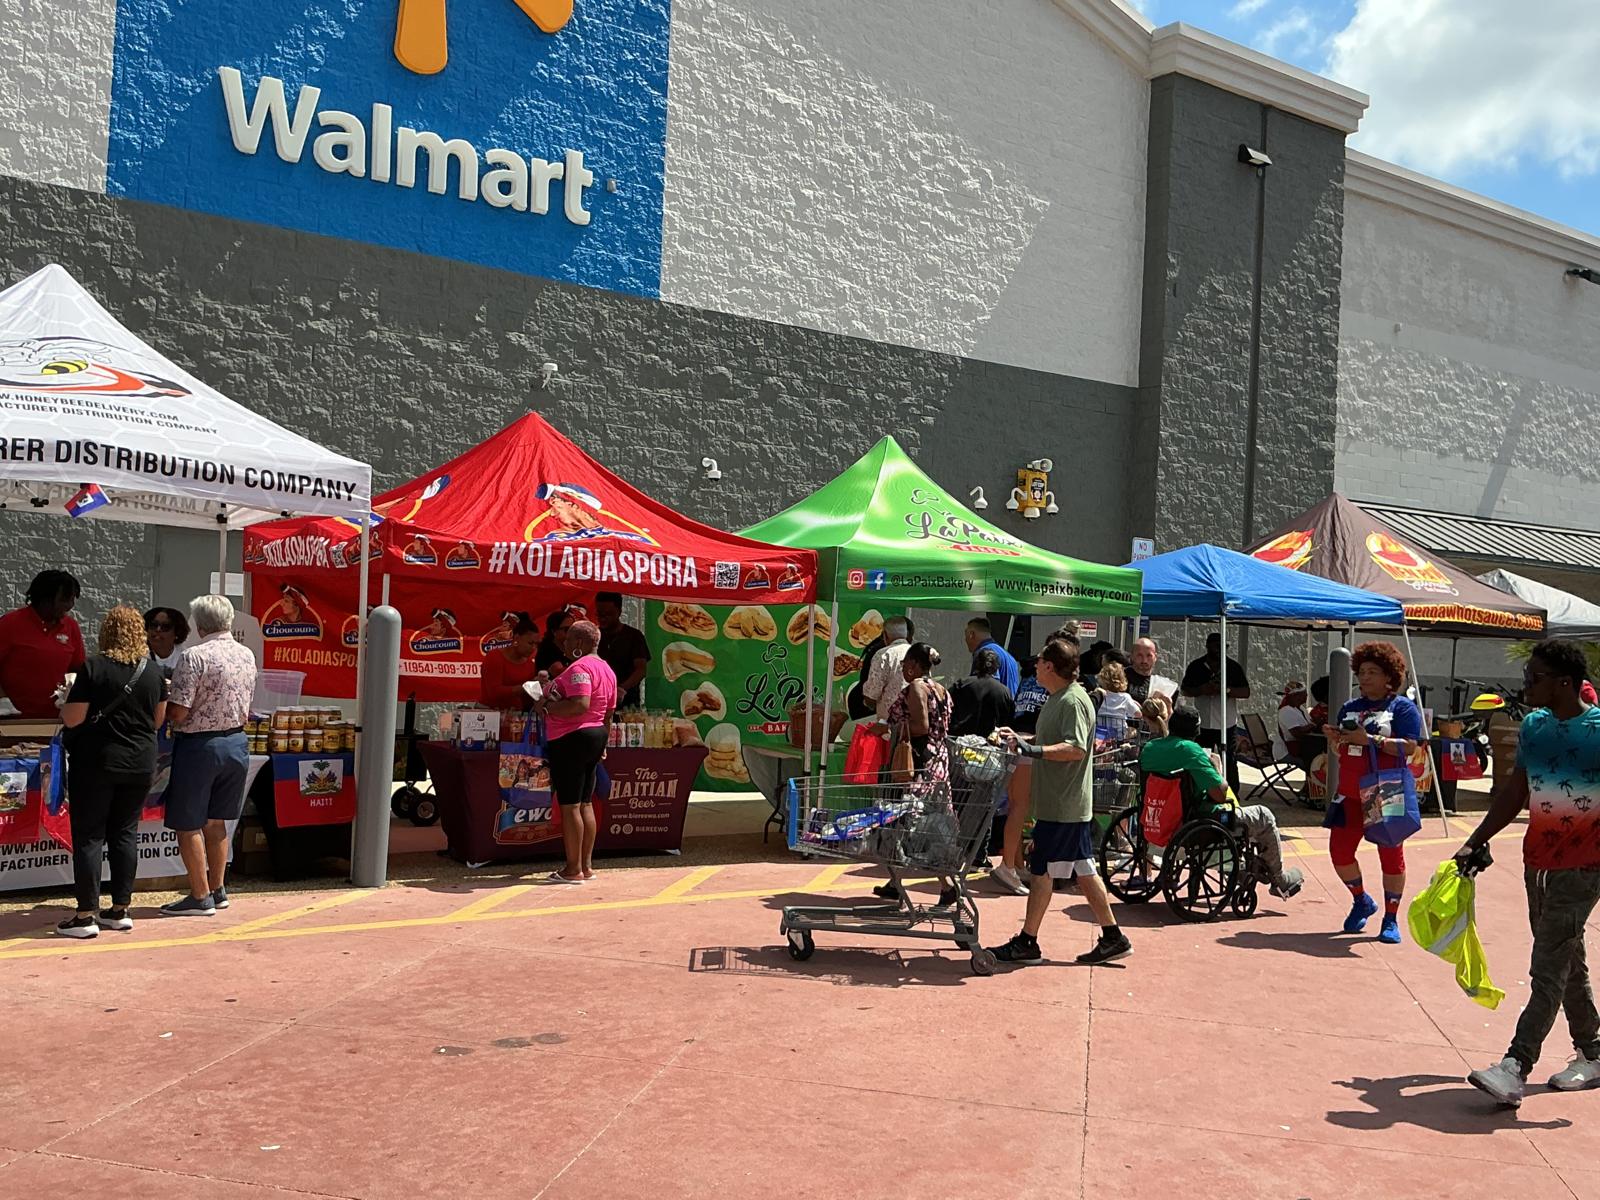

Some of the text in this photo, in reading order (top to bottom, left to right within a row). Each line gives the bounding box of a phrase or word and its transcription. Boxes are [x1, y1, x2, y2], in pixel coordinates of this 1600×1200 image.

[216, 66, 594, 226] Walmart
[62, 407, 153, 425] DISTRIBUTION
[157, 420, 218, 435] COMPANY
[54, 438, 236, 485] DISTRIBUTION
[244, 466, 357, 502] COMPANY
[488, 541, 698, 588] #KOLADIASPORA
[891, 575, 974, 590] @LaPaixBakery
[994, 578, 1132, 602] www.lapaixbakery.com
[273, 646, 358, 668] #KOLADIASPO
[736, 672, 781, 722] La
[635, 767, 658, 780] The
[608, 779, 679, 800] HAITIAN
[310, 798, 333, 807] HAITI
[629, 797, 656, 809] Beer
